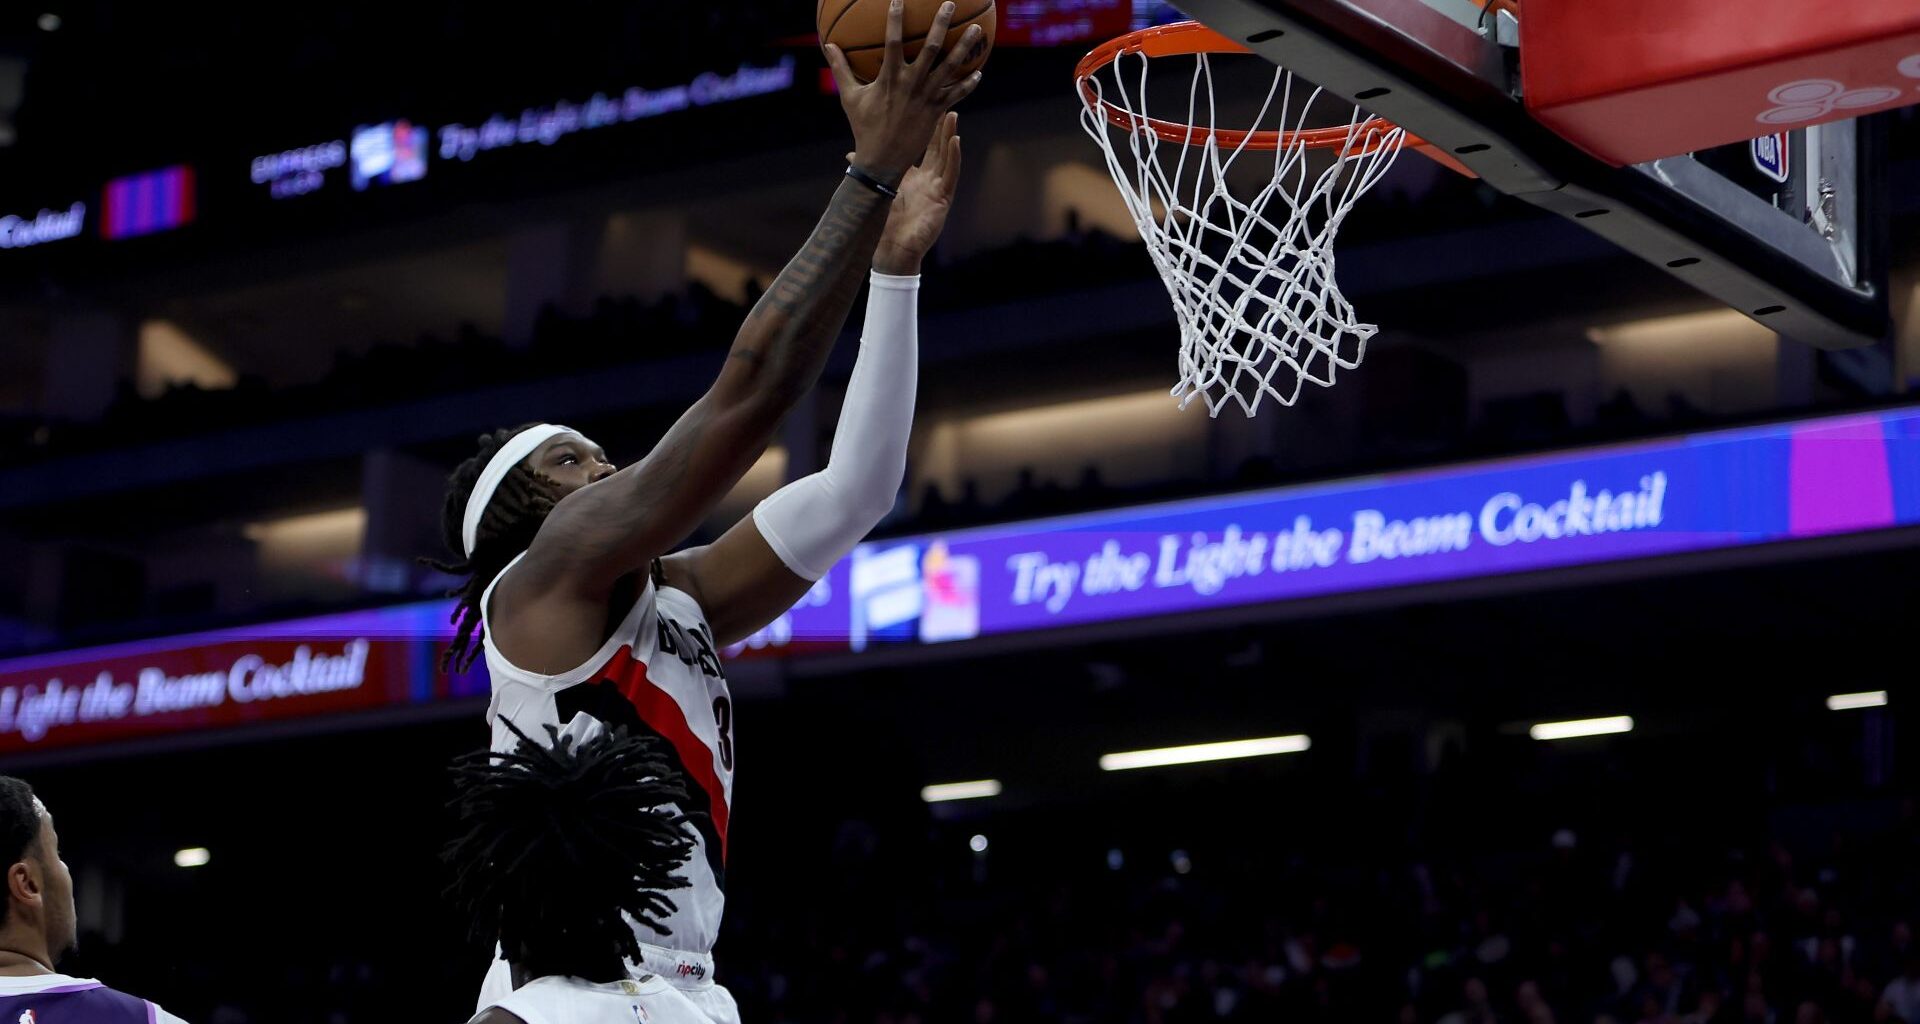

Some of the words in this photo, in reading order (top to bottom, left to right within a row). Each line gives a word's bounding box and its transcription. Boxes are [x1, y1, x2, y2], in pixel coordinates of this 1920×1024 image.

[1006, 551, 1080, 614] Try
[1081, 538, 1151, 596] the
[1153, 523, 1269, 596] Light
[1270, 513, 1344, 573] the
[1346, 508, 1473, 564] Beam
[1478, 470, 1668, 546] Cocktail
[78, 670, 135, 723] the
[134, 667, 228, 717] Beam
[228, 638, 370, 703] Cocktail
